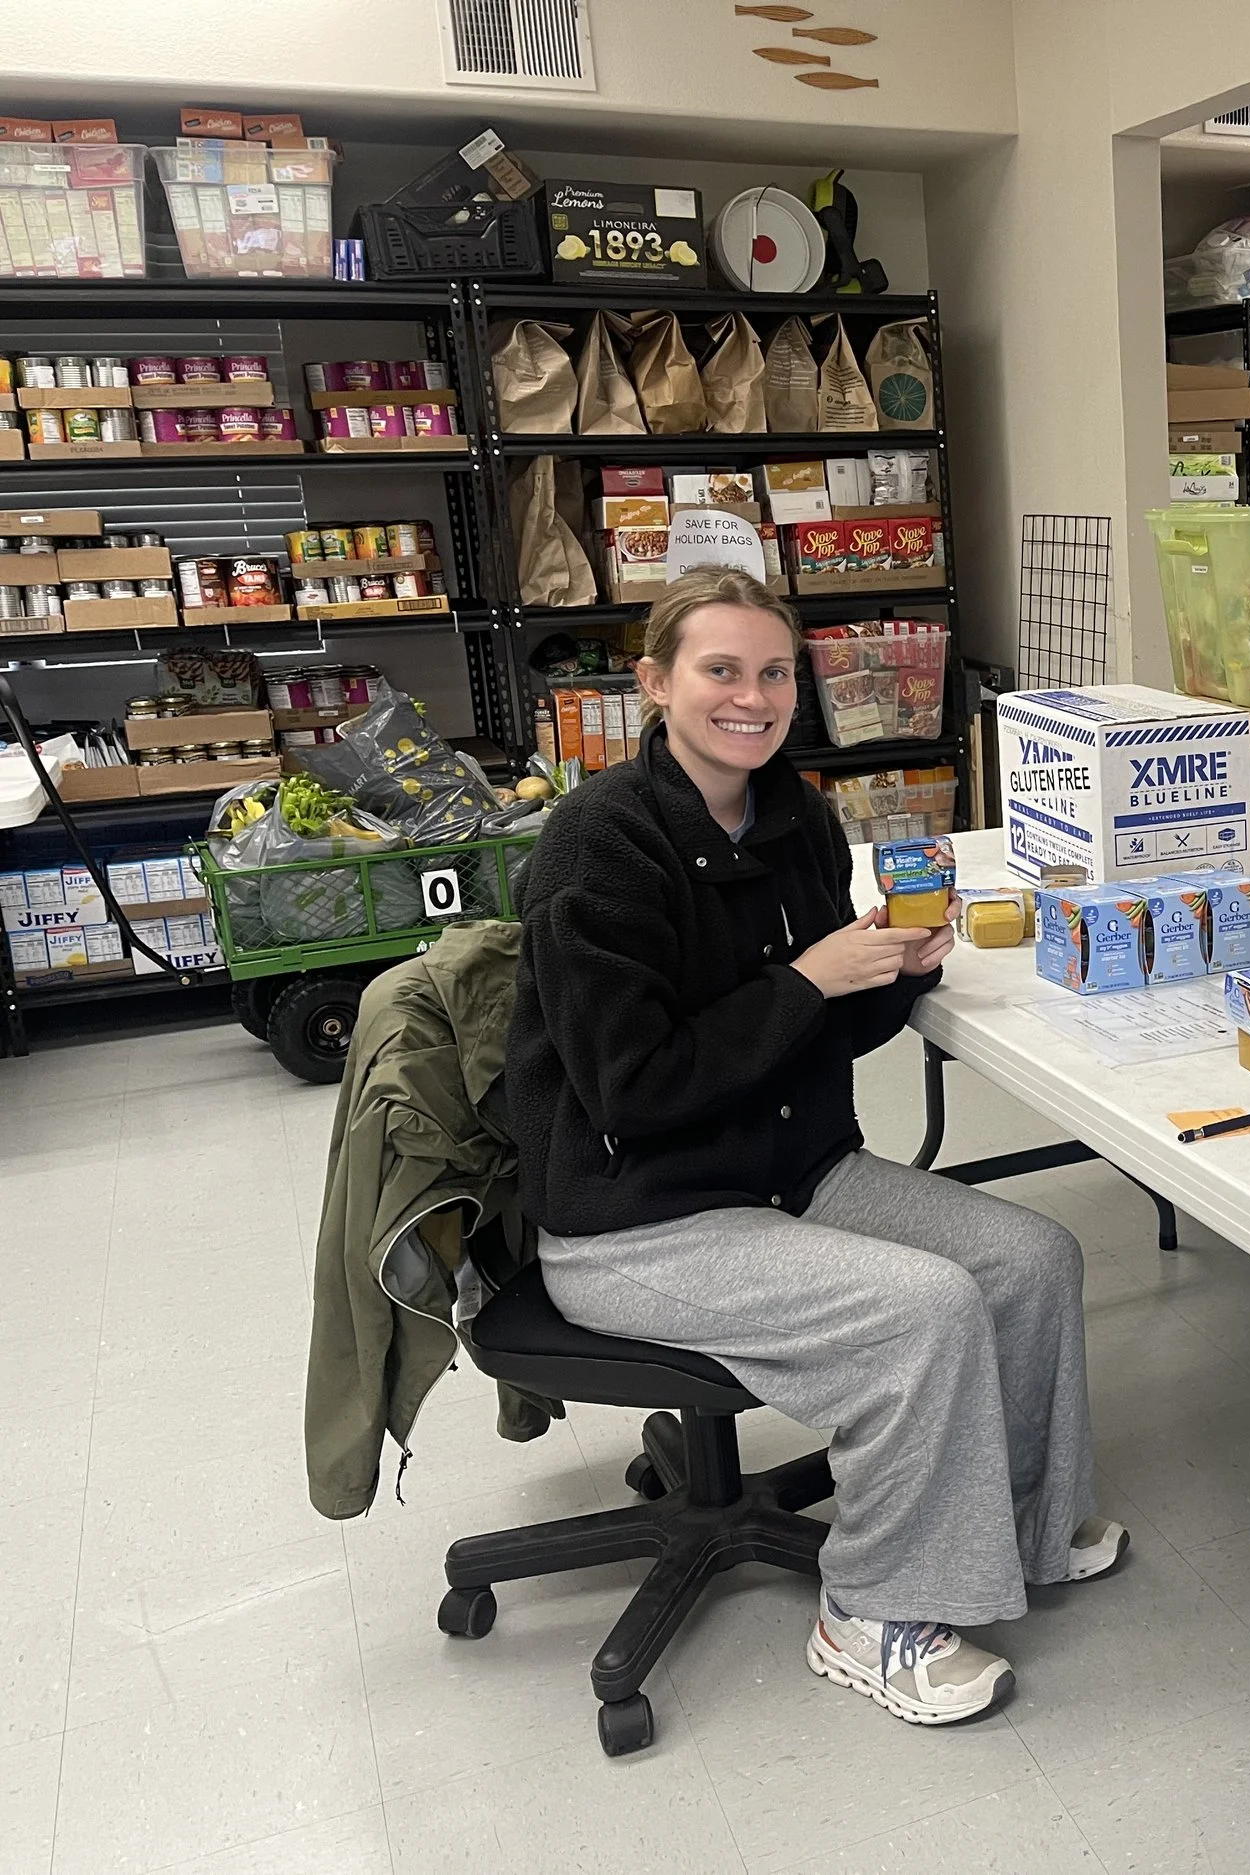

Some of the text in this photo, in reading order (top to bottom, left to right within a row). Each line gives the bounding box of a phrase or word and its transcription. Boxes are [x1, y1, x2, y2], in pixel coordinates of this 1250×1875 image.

[565, 185, 604, 198] Premium
[551, 191, 604, 210] Lemons
[593, 219, 657, 231] LIMONEIRA
[588, 229, 664, 262] 1893
[222, 413, 253, 423] Princella
[685, 519, 738, 530] SAVE FOR
[675, 535, 753, 545] HOLIDAY BAGS
[804, 530, 838, 553] Stove
[849, 528, 884, 552] Stove
[894, 526, 926, 550] Stove
[817, 543, 835, 558] Top
[863, 541, 880, 556] Top
[907, 539, 923, 554] Top
[232, 560, 267, 576] Bruce's
[902, 676, 935, 697] Stove
[914, 689, 931, 702] Top
[1129, 751, 1228, 788] XMRE
[1010, 767, 1091, 792] GLUTEN FREE
[1130, 786, 1228, 807] BLUELINE
[1011, 824, 1026, 854] 12
[1026, 831, 1093, 866] CONTAINS TWELVE COMPLETE
[1027, 841, 1047, 857] READY
[1047, 850, 1057, 863] TO
[65, 876, 92, 885] JIFF
[429, 877, 454, 910] 0
[18, 911, 79, 928] JIFFY
[1043, 916, 1066, 933] Gerber
[1219, 913, 1250, 923] Gerber
[1161, 923, 1194, 934] Gerber
[49, 935, 82, 944] JIFFY
[1096, 932, 1132, 943] Gerber
